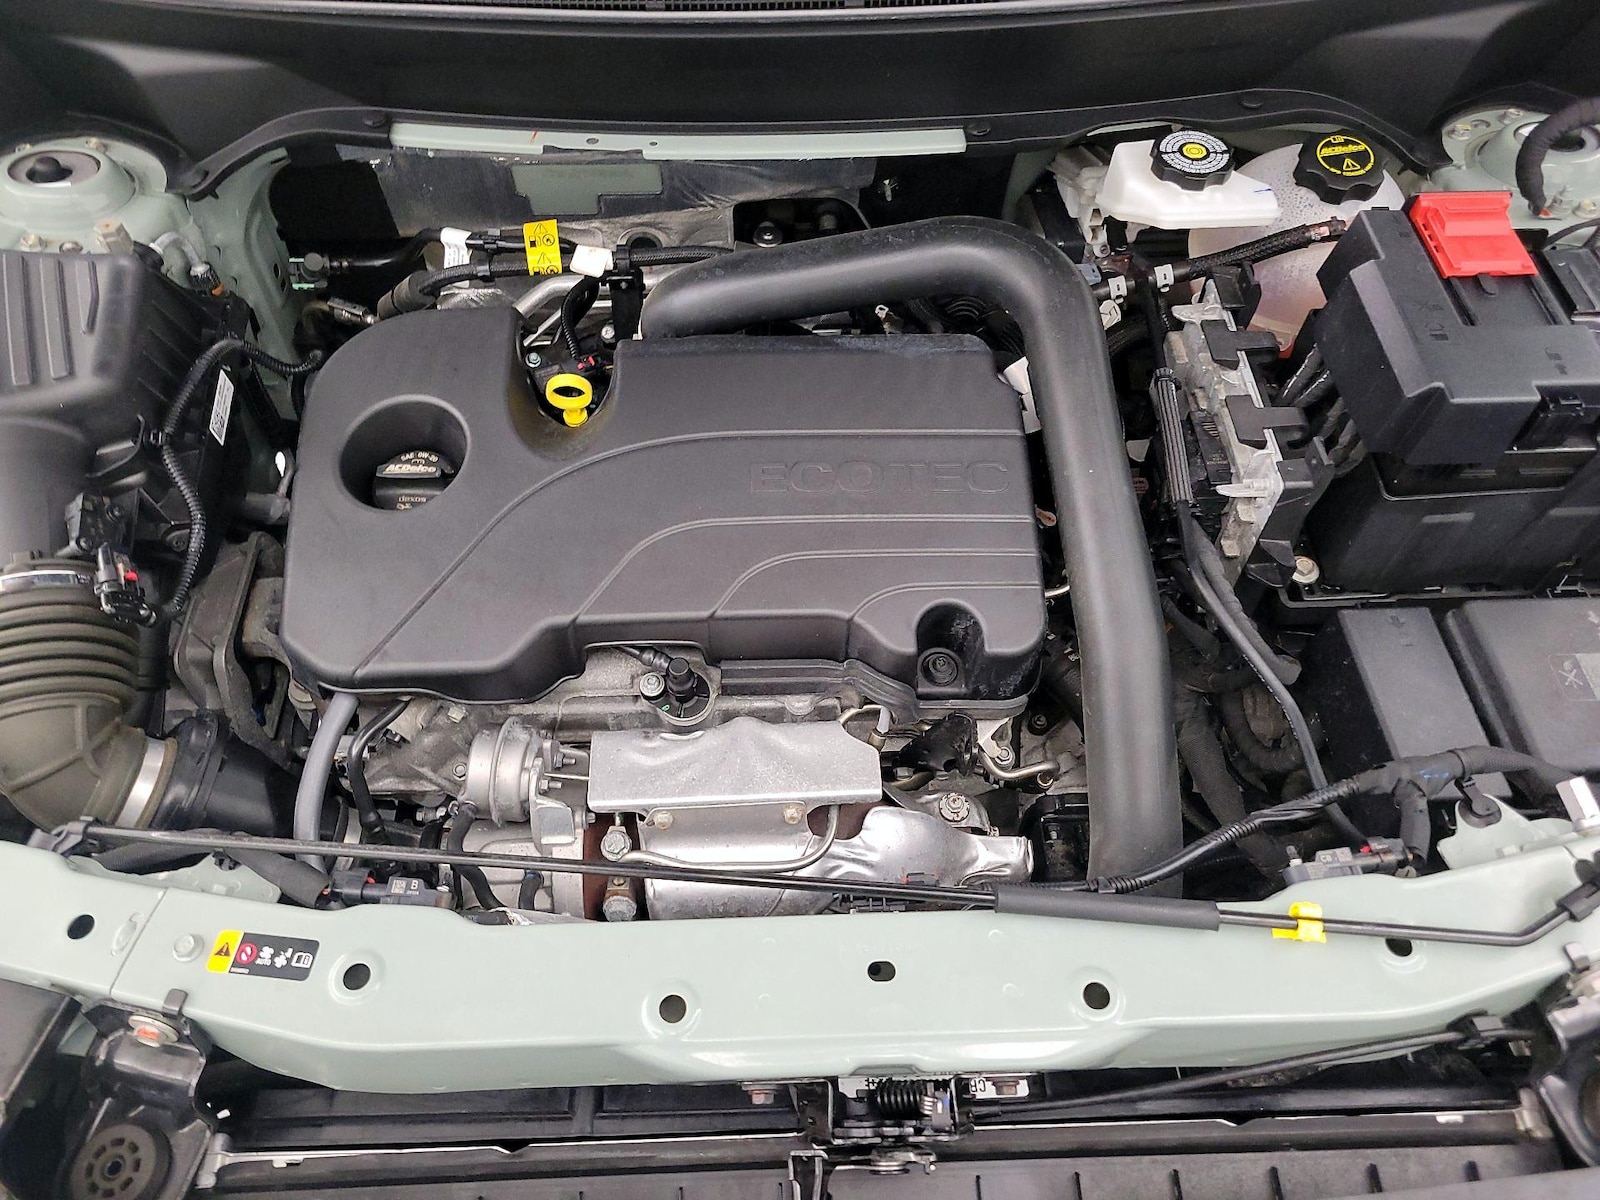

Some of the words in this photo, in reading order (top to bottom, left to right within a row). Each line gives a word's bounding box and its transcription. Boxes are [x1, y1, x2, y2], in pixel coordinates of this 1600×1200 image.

[401, 452, 415, 461] SAE
[385, 464, 437, 473] ACDelco
[750, 460, 1011, 494] ECOTEC
[398, 495, 427, 503] dexos
[411, 880, 419, 890] B
